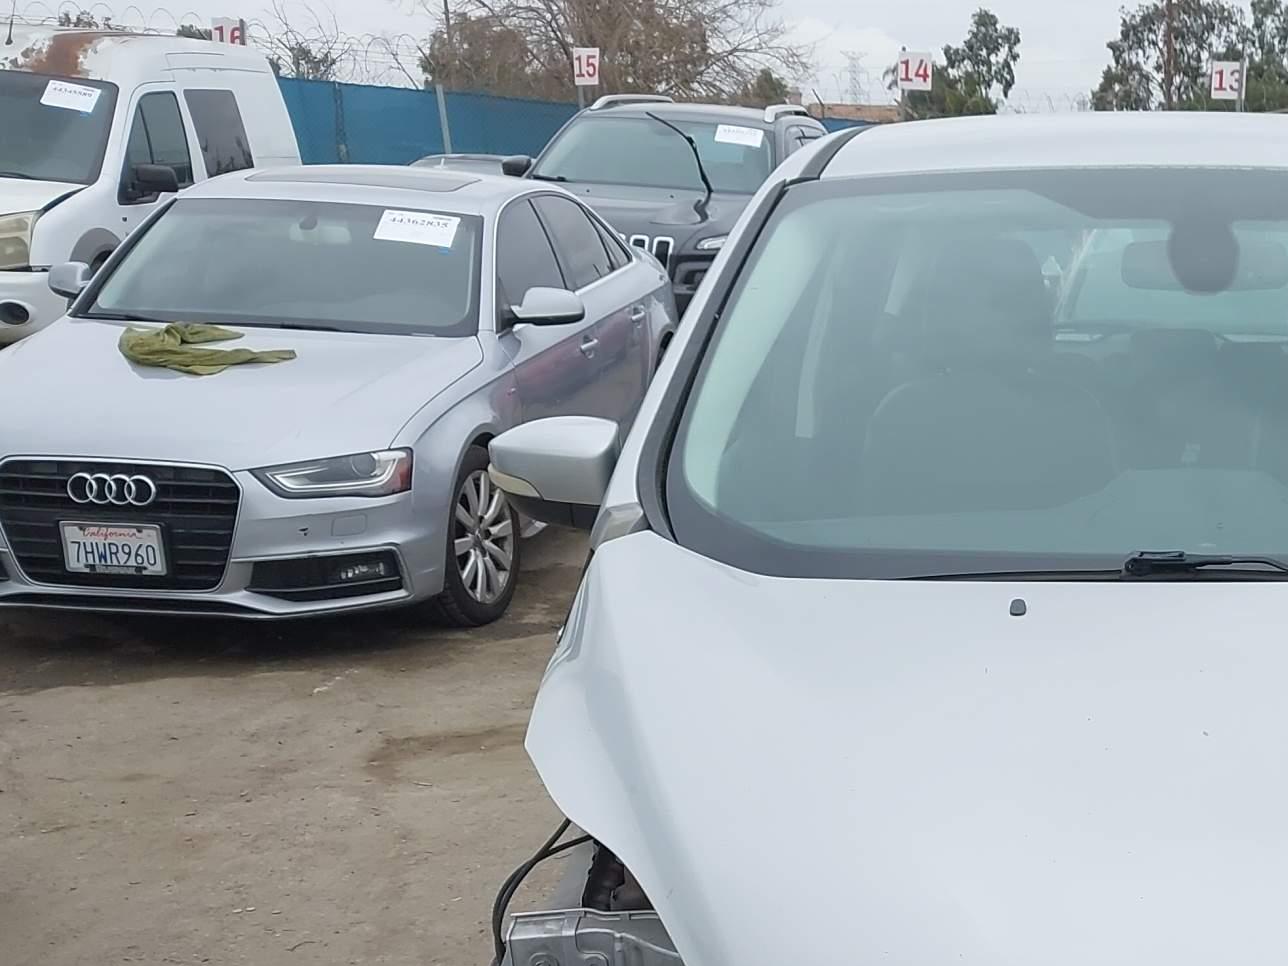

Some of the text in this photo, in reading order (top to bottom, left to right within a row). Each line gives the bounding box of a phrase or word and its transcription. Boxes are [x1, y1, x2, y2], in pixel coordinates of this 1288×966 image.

[575, 54, 597, 78] 15
[900, 58, 929, 83] 14
[81, 526, 138, 541] California
[70, 541, 158, 567] 7HWR960
